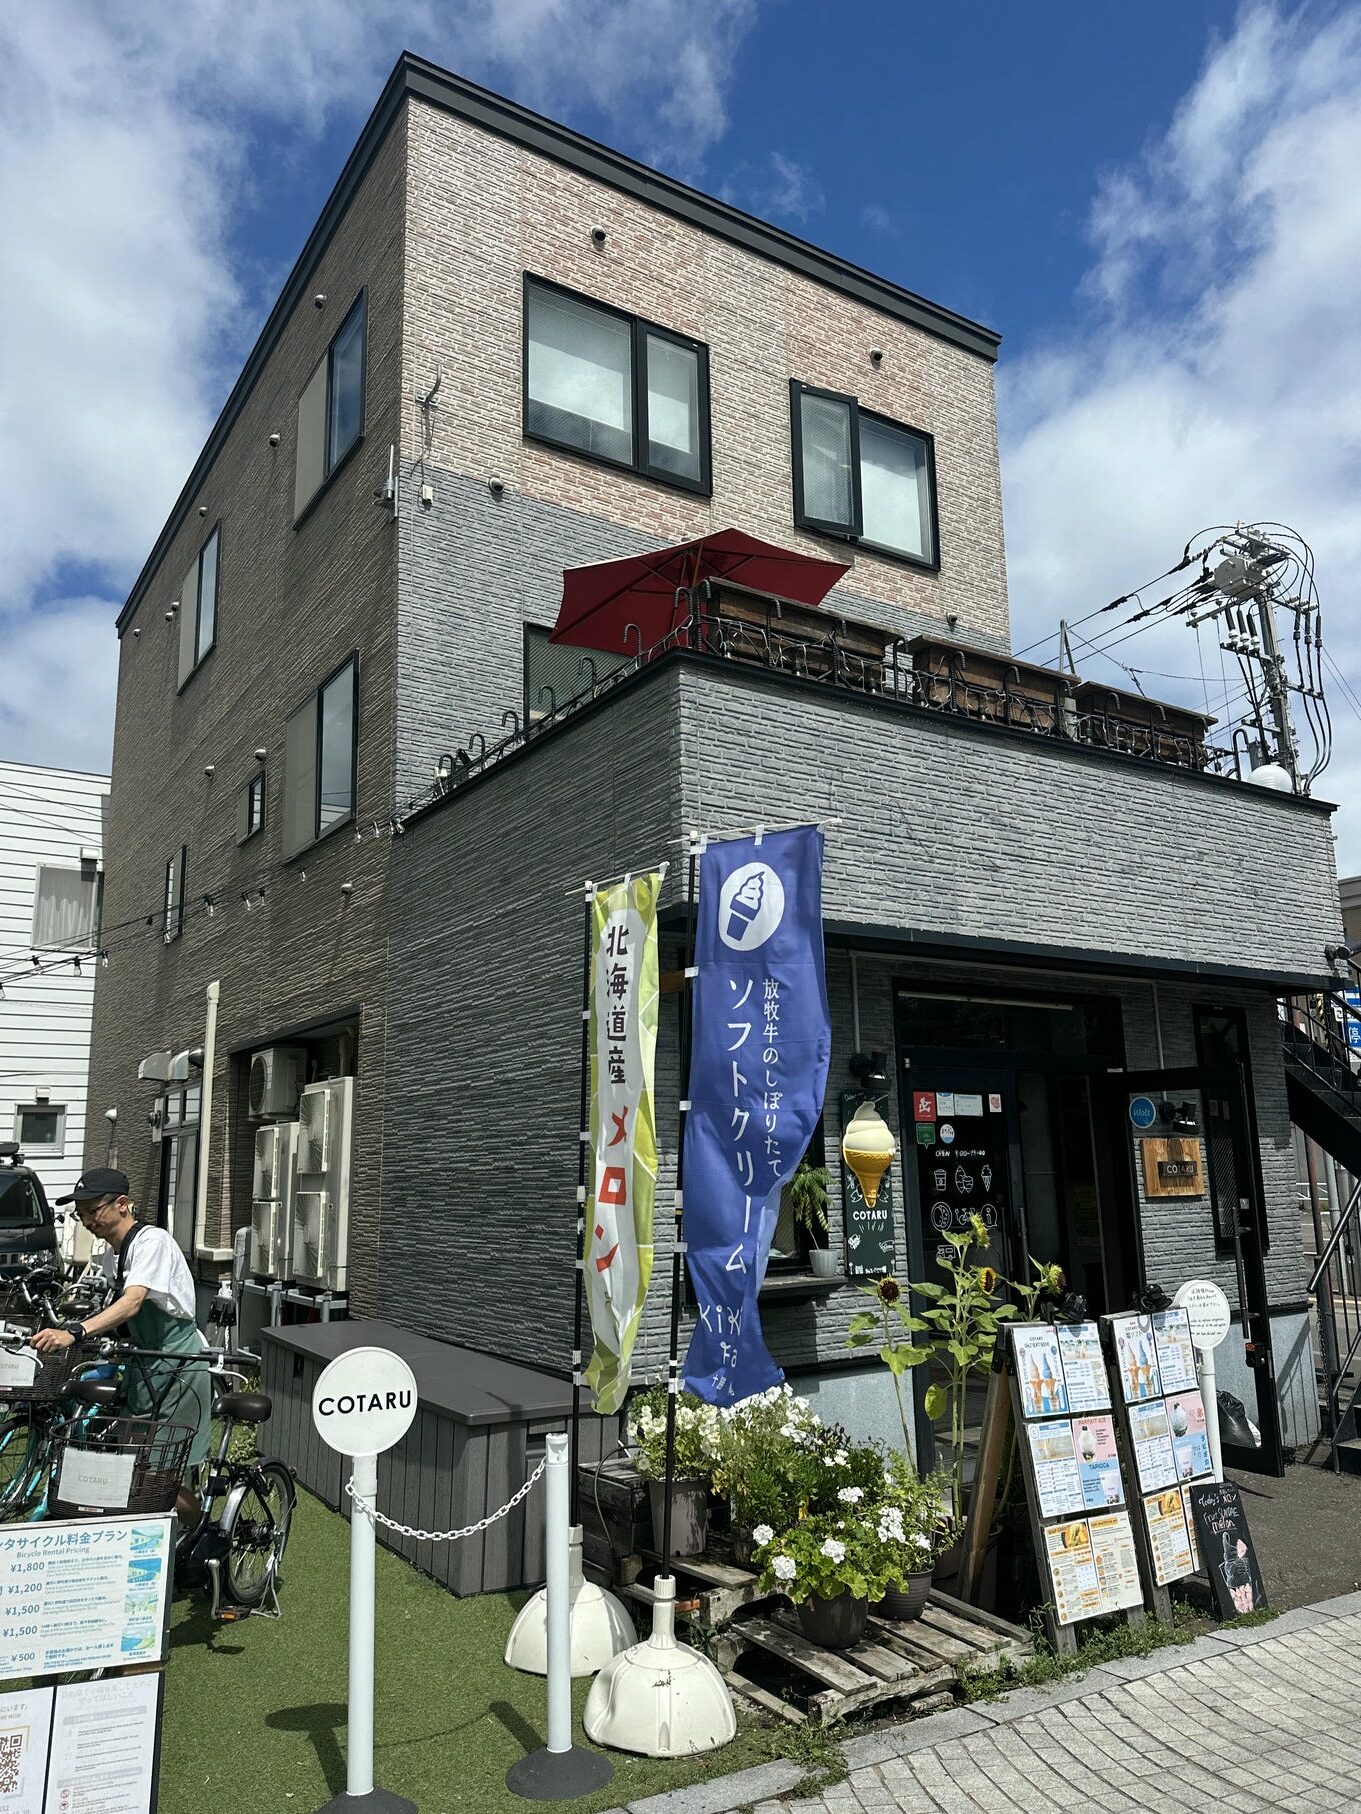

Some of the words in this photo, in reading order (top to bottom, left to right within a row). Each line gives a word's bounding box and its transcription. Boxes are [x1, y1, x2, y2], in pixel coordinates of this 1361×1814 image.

[604, 924, 630, 1086] 北海道産
[762, 978, 784, 1178] 放牧牛のしぼりたて
[726, 978, 755, 1275] ソフトクリーム
[594, 1105, 630, 1274] メロン
[852, 1209, 888, 1221] COTARU
[318, 1389, 413, 1417] COTARU
[78, 1474, 109, 1486] COTARU
[0, 1530, 128, 1551] タサイクル料金プラン
[16, 1550, 42, 1559] Bicycle
[42, 1547, 65, 1556] Rental
[66, 1546, 90, 1555] Pricing
[10, 1561, 45, 1575] ¥1,800
[8, 1582, 43, 1595] ¥1,200
[5, 1604, 40, 1617] ¥1,500
[3, 1625, 38, 1638] ¥1,500
